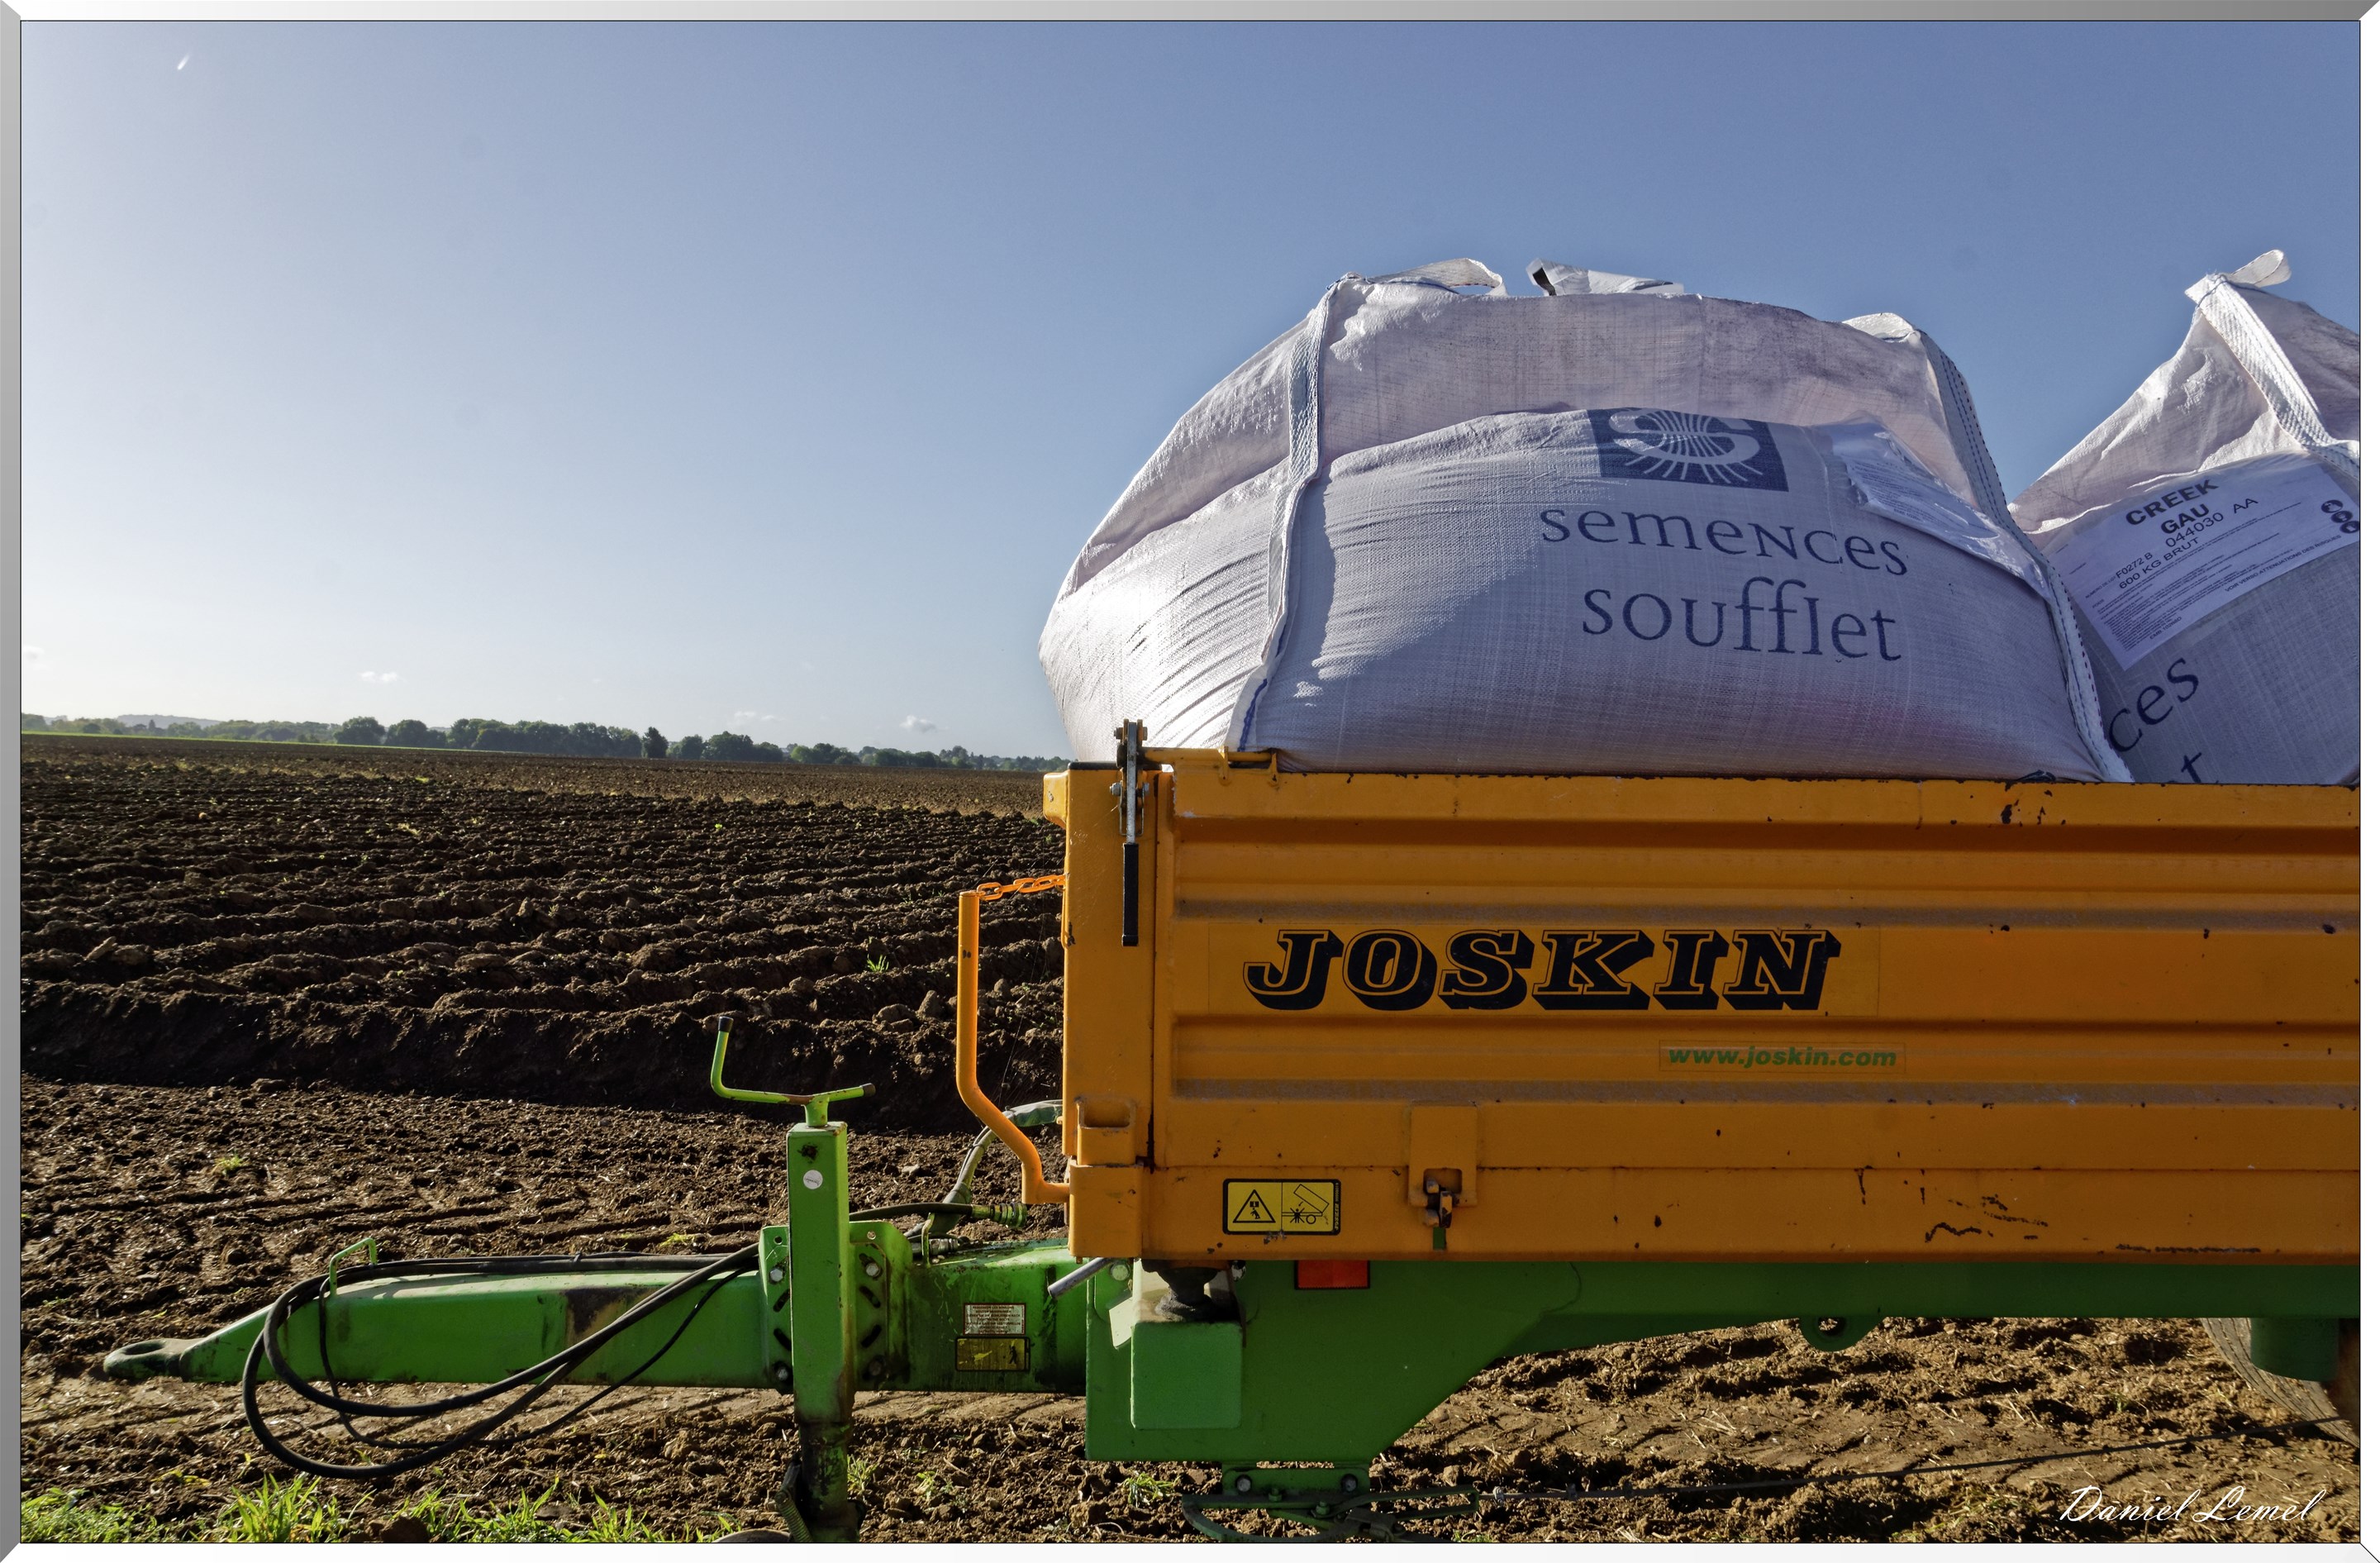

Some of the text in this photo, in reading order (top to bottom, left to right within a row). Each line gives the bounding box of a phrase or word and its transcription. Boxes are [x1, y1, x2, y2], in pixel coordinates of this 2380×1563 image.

[2125, 479, 2219, 525] CREEK
[2160, 503, 2210, 534] GAU
[2165, 512, 2224, 547] 044030
[2233, 498, 2259, 513] AA
[2116, 557, 2144, 579] F0272
[2144, 552, 2153, 561] B
[2119, 572, 2140, 589] 600
[2142, 560, 2162, 574] KG
[2163, 536, 2200, 561] BRUT
[1583, 576, 1902, 661] soufflet
[1243, 929, 1840, 1010] JOSKIN
[1668, 1046, 1897, 1068] www.joskin.com
